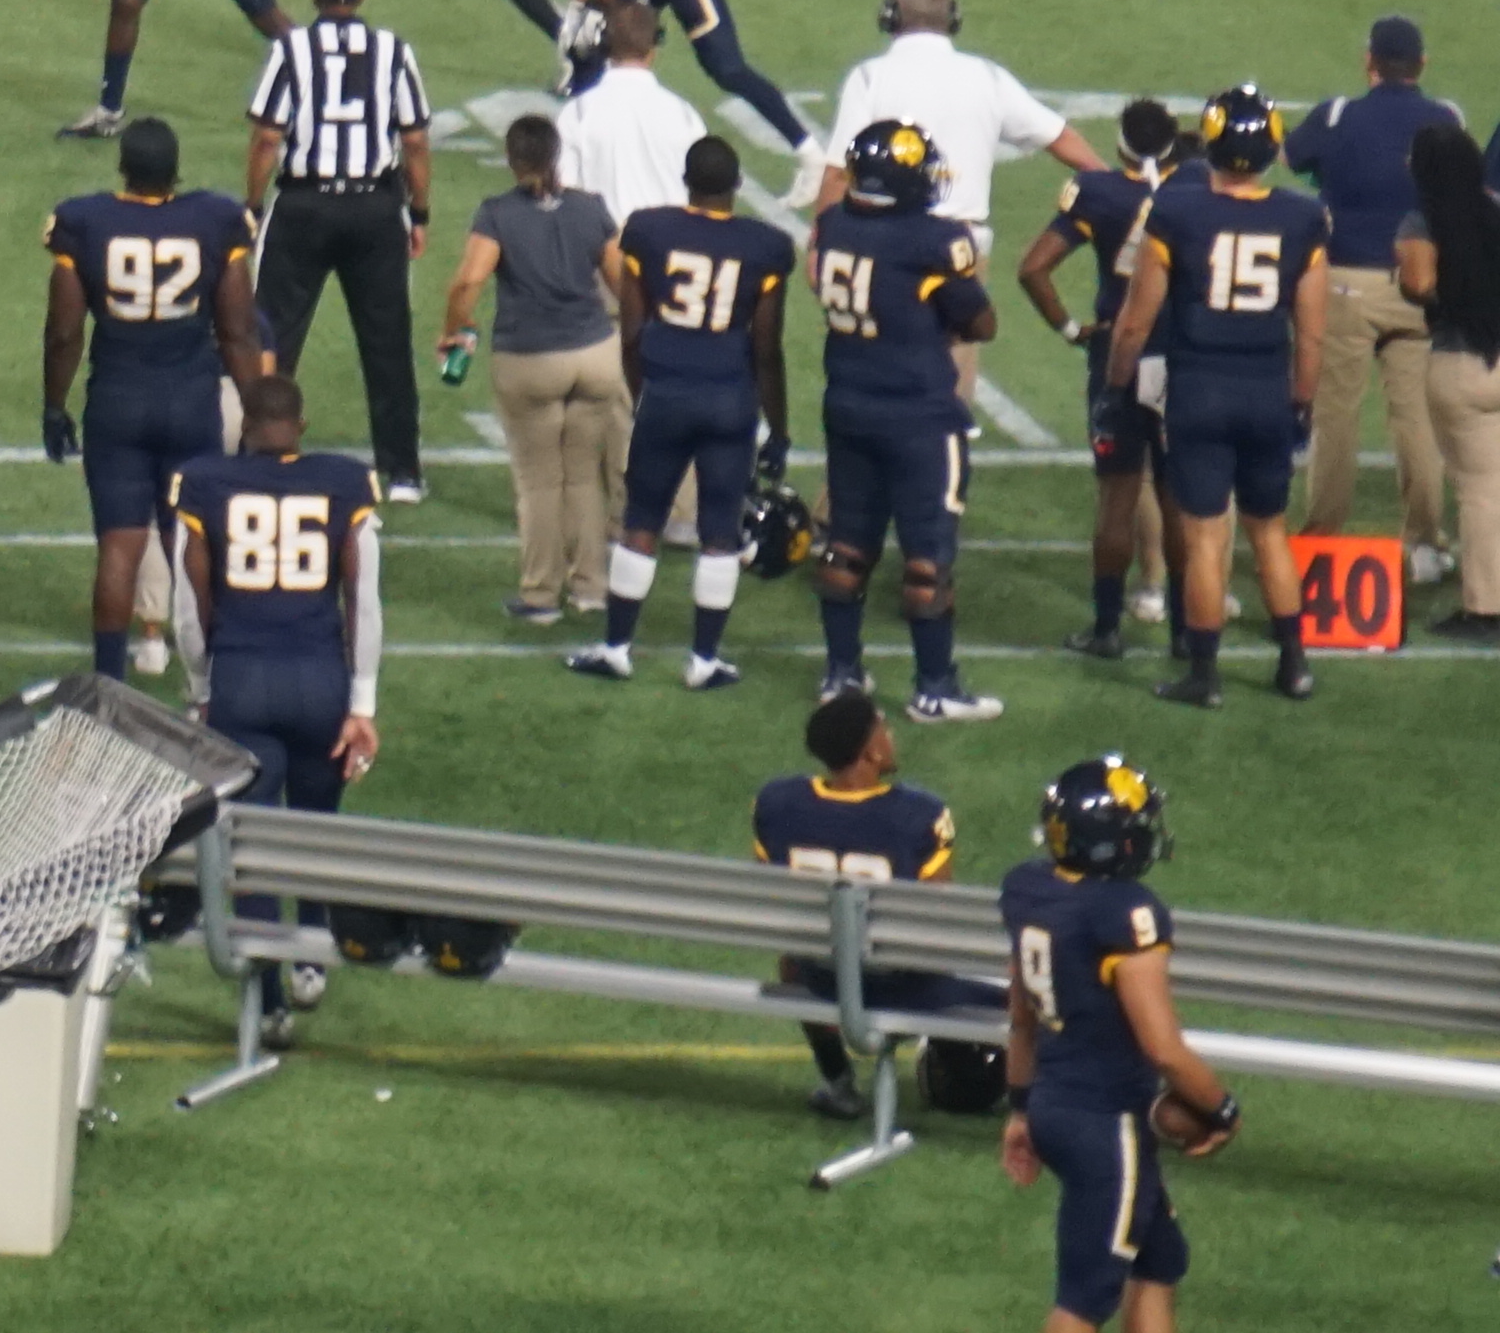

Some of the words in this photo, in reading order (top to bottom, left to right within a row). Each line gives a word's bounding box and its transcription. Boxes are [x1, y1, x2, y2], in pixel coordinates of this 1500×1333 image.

[322, 56, 364, 121] L
[105, 236, 202, 321] 92
[658, 250, 742, 333] 31
[819, 248, 879, 340] 61
[1207, 231, 1284, 313] 15
[226, 493, 331, 593] 86
[1301, 554, 1391, 636] 40
[1130, 905, 1159, 949] 9
[1018, 926, 1063, 1033] 9
